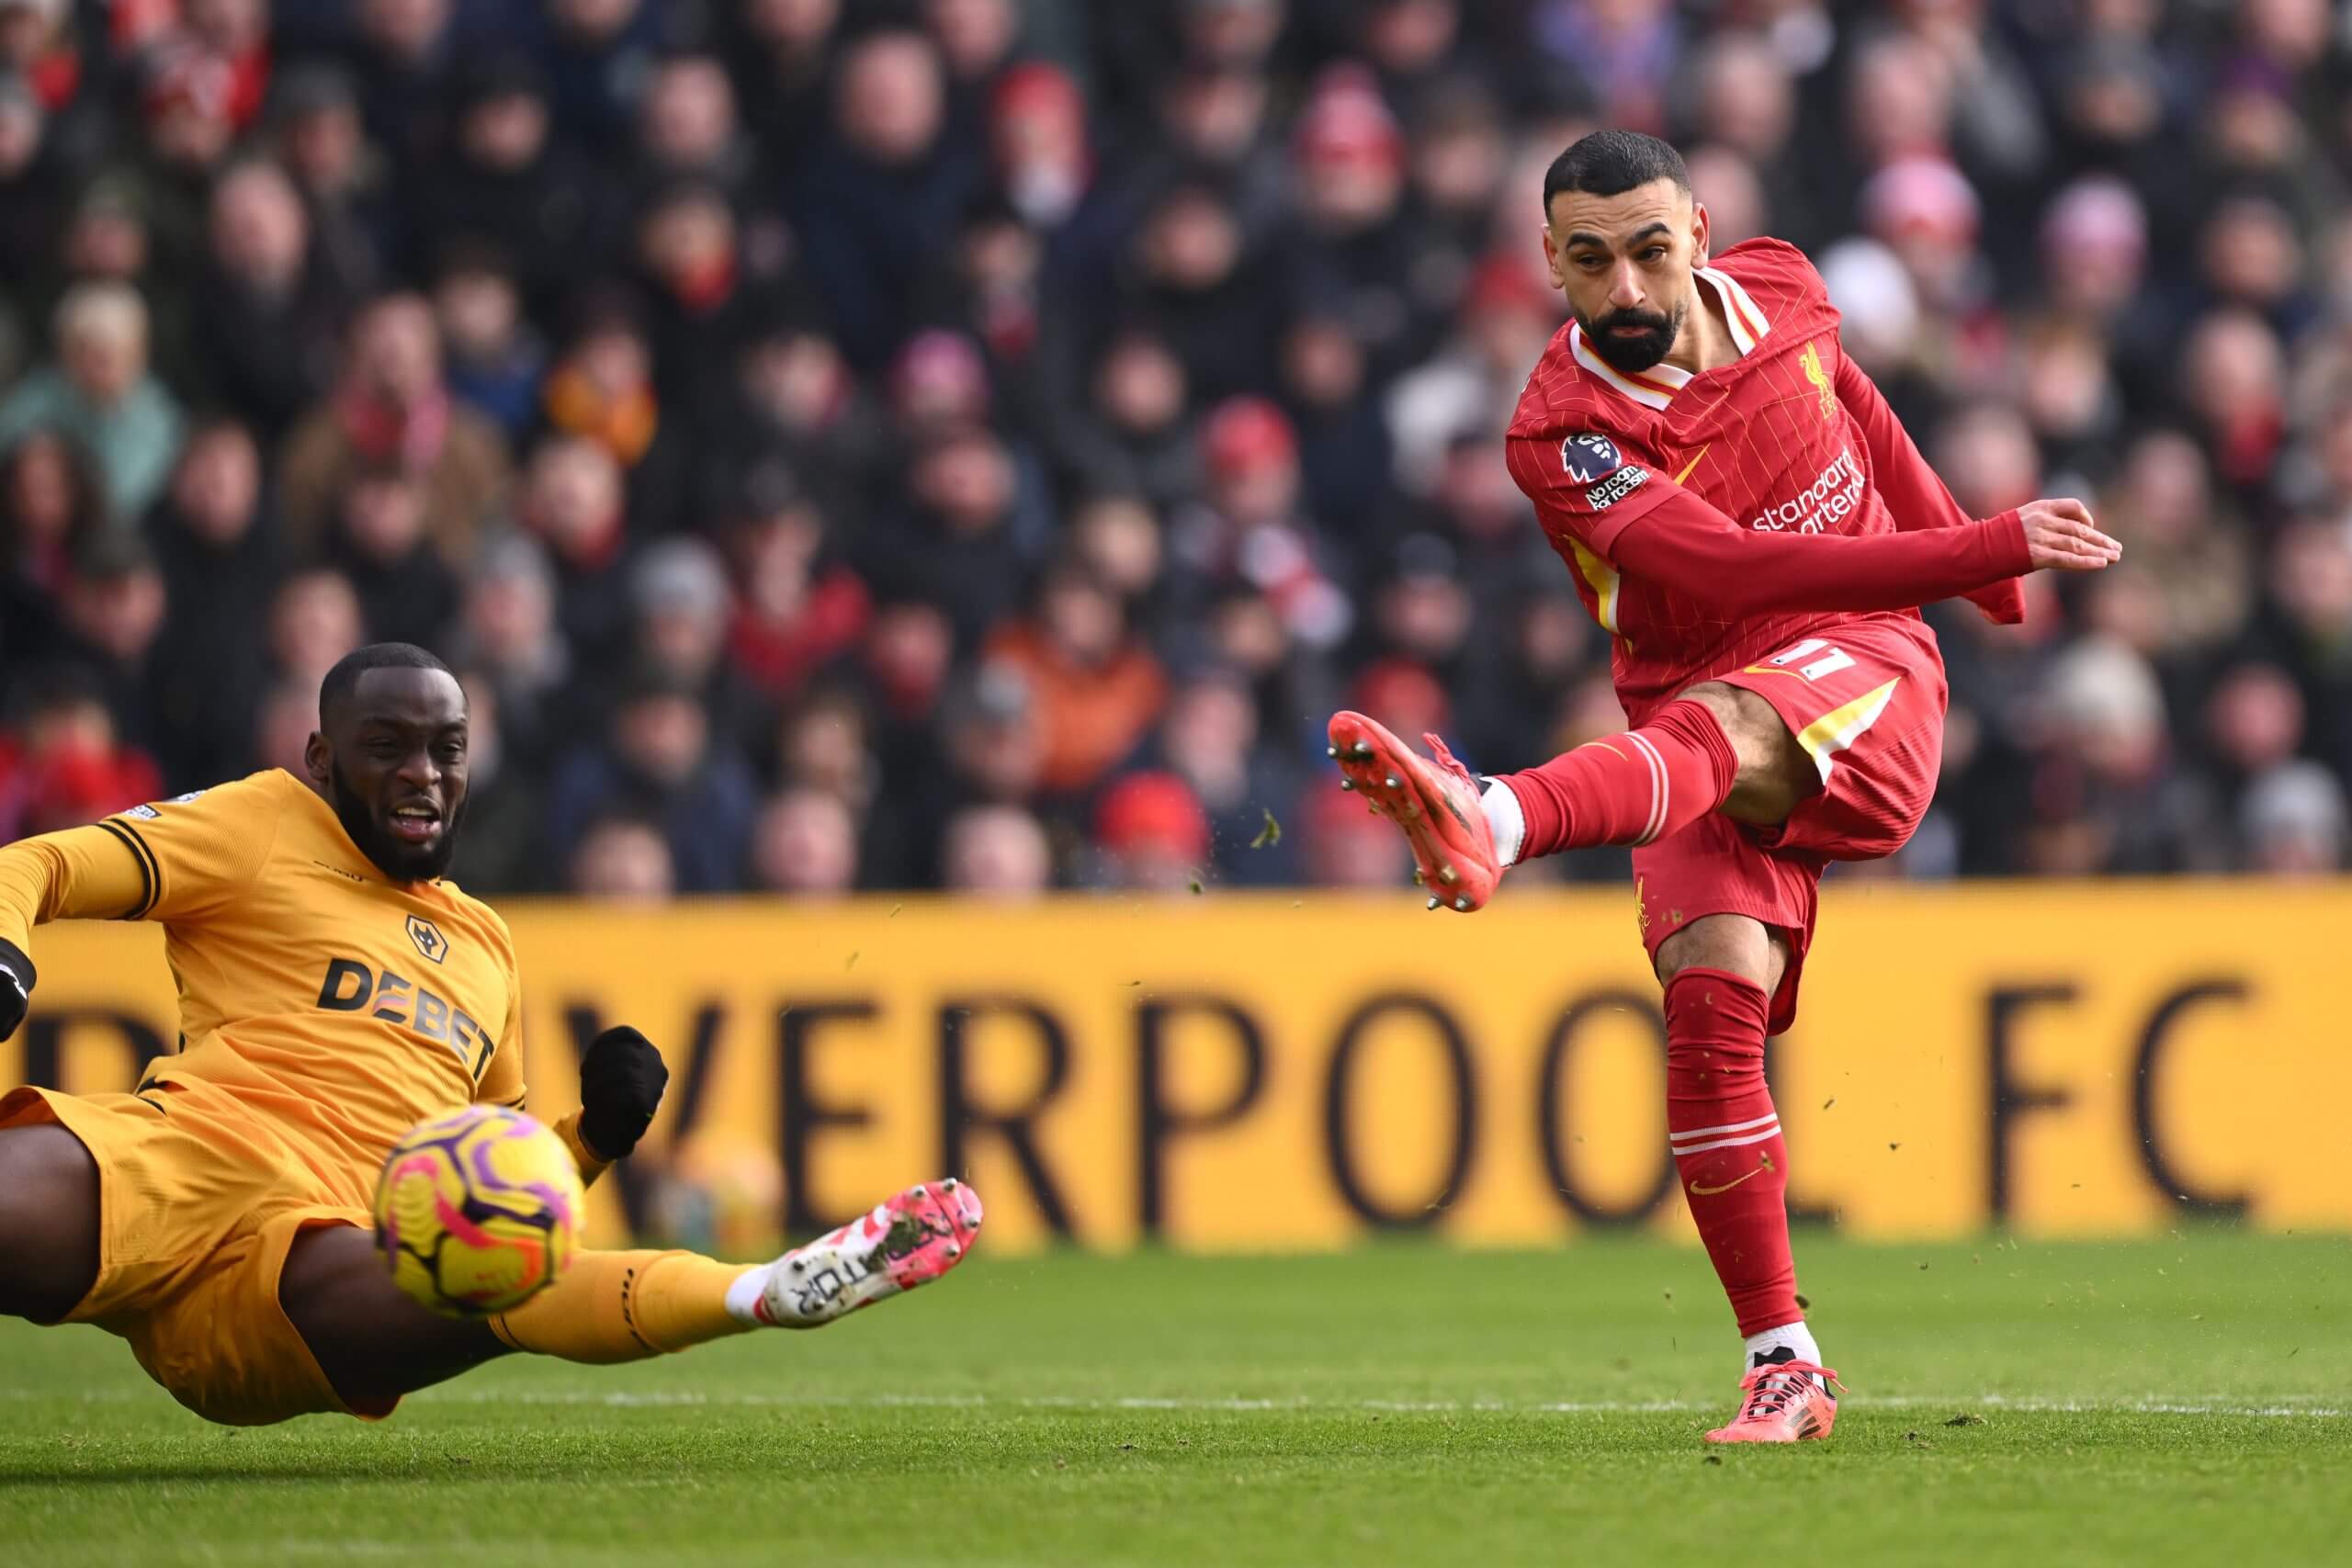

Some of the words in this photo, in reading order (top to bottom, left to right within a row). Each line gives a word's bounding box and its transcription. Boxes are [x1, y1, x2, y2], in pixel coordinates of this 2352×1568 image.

[1585, 487, 1606, 506] No
[1604, 466, 1638, 491] room
[1592, 496, 1611, 511] for
[1611, 469, 1651, 500] racism
[1753, 446, 1855, 532] standard
[1769, 637, 1857, 681] 11
[316, 957, 494, 1081] DEBET
[1983, 977, 2256, 1224] FC
